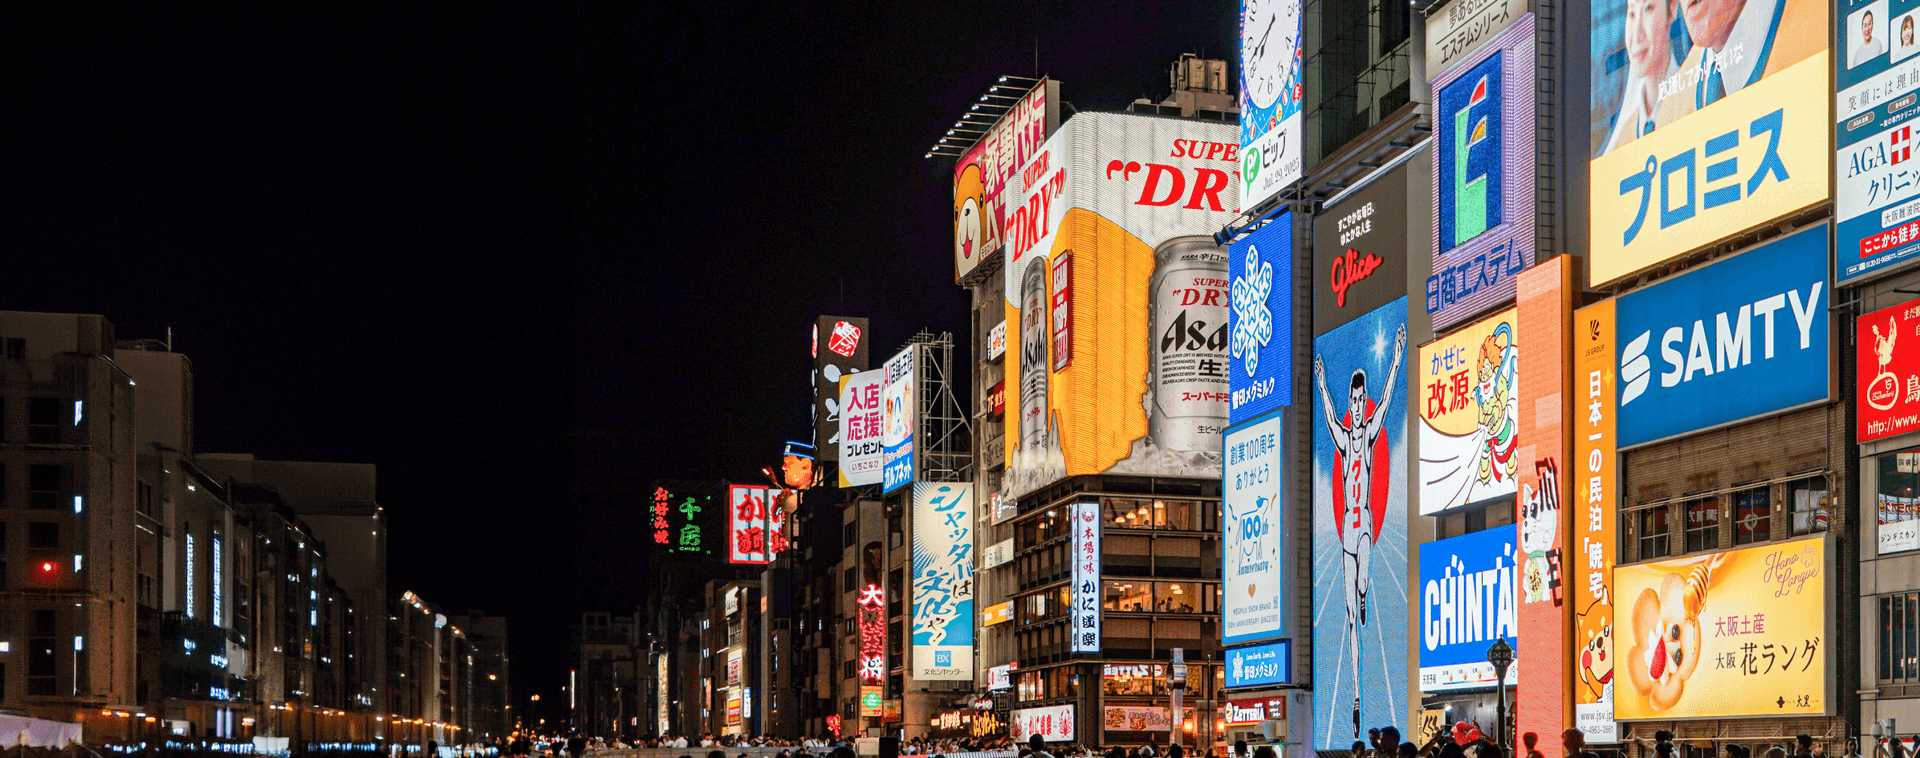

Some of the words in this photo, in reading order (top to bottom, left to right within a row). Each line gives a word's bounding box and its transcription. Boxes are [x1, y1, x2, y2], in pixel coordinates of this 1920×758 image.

[1449, 0, 1487, 29] 夢ある
[1171, 139, 1240, 162] SUPE
[1262, 127, 1288, 169] ピップ
[1847, 141, 1888, 179] AGA
[1023, 150, 1049, 193] SUPER
[1106, 160, 1240, 213] “DR
[1619, 108, 1790, 247] プロミス
[1331, 248, 1384, 307] Glico
[1426, 238, 1523, 315] 日商エステム
[1661, 281, 1823, 387] SAMTY
[1199, 359, 1223, 377] 生
[1431, 345, 1465, 375] かぜに
[847, 383, 879, 412] 入店
[1232, 377, 1275, 410] 雪印メグミルク
[1427, 368, 1470, 420] 改源
[847, 411, 883, 441] 応援
[1230, 432, 1275, 465] 創業100周年
[1236, 463, 1269, 490] ありがとう
[1352, 454, 1361, 529] グリコ
[679, 497, 701, 546] 千房
[1083, 526, 1095, 574] 本場の味
[1763, 551, 1799, 584] Hana
[1715, 612, 1765, 637] 大阪土産
[937, 654, 949, 663] BX
[1244, 662, 1278, 680] 雪印メグミルク
[1715, 651, 1736, 669] 大阪
[1740, 636, 1820, 676] 花ラング
[1796, 694, 1810, 707] 大黒
